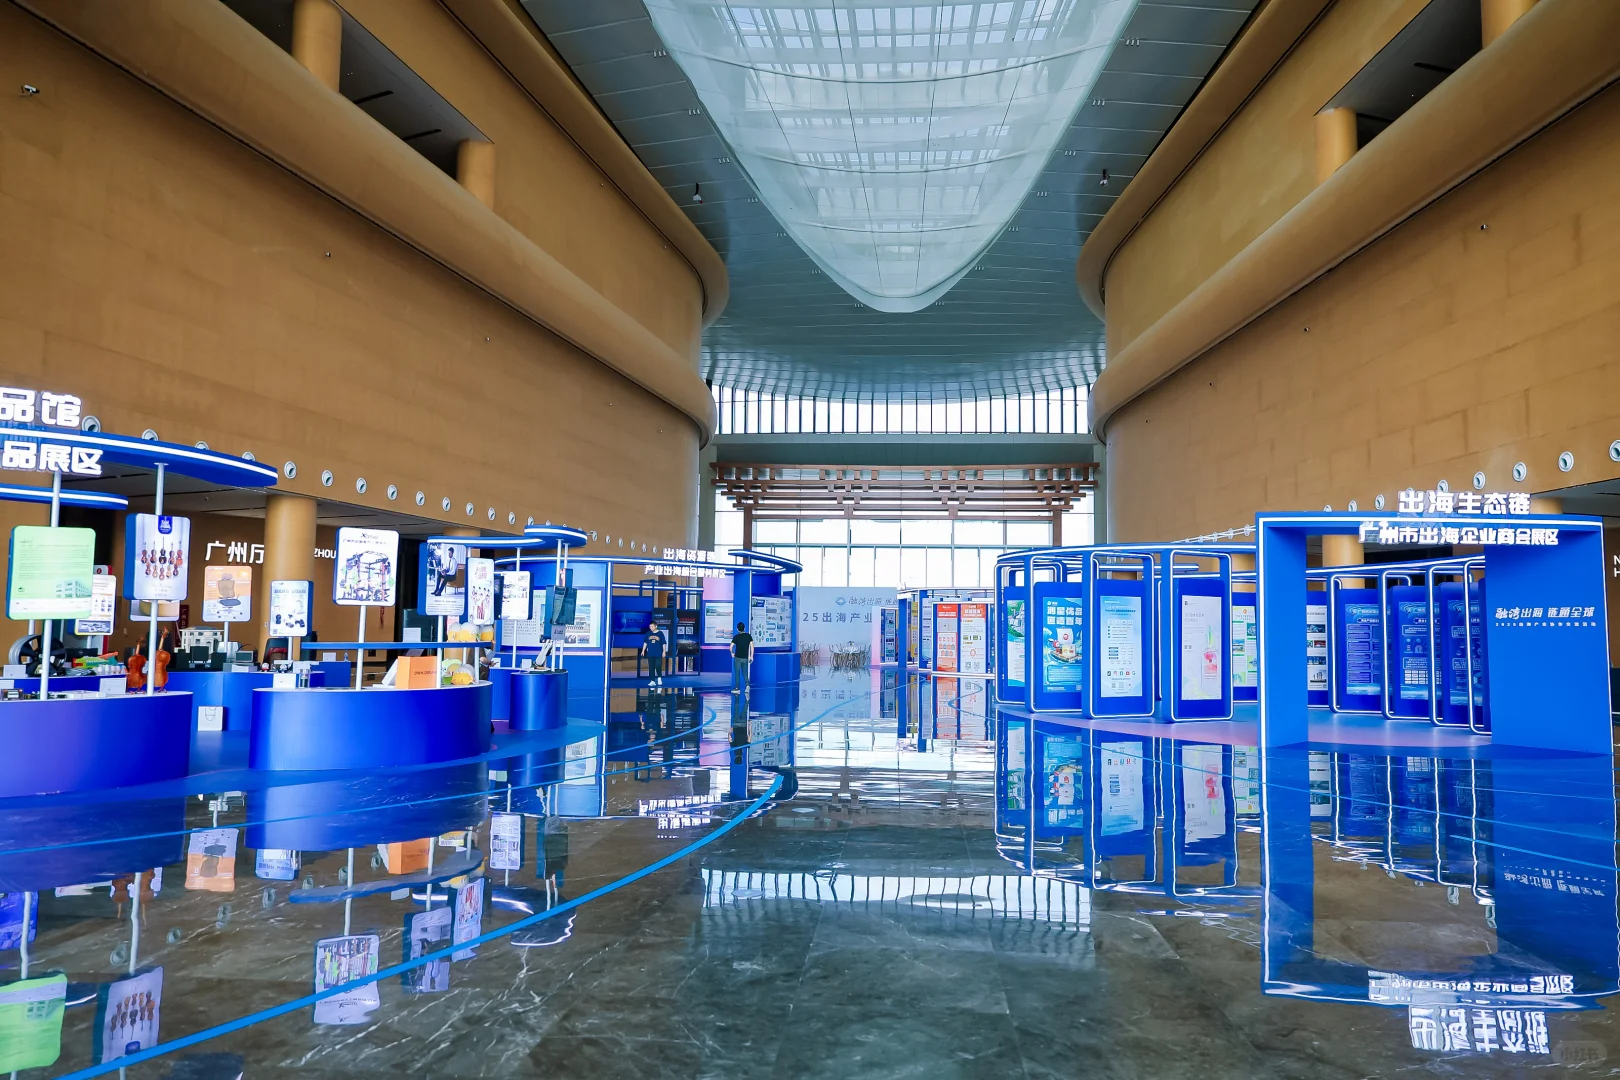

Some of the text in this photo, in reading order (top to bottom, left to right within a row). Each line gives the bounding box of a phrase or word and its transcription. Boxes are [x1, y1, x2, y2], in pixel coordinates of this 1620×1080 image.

[0, 387, 82, 428] 品馆
[2, 440, 104, 476] 品展区
[1399, 491, 1531, 515] 出海生态链
[1359, 521, 1559, 546] 广州市出海企业商会展区
[205, 541, 265, 564] 广州厅
